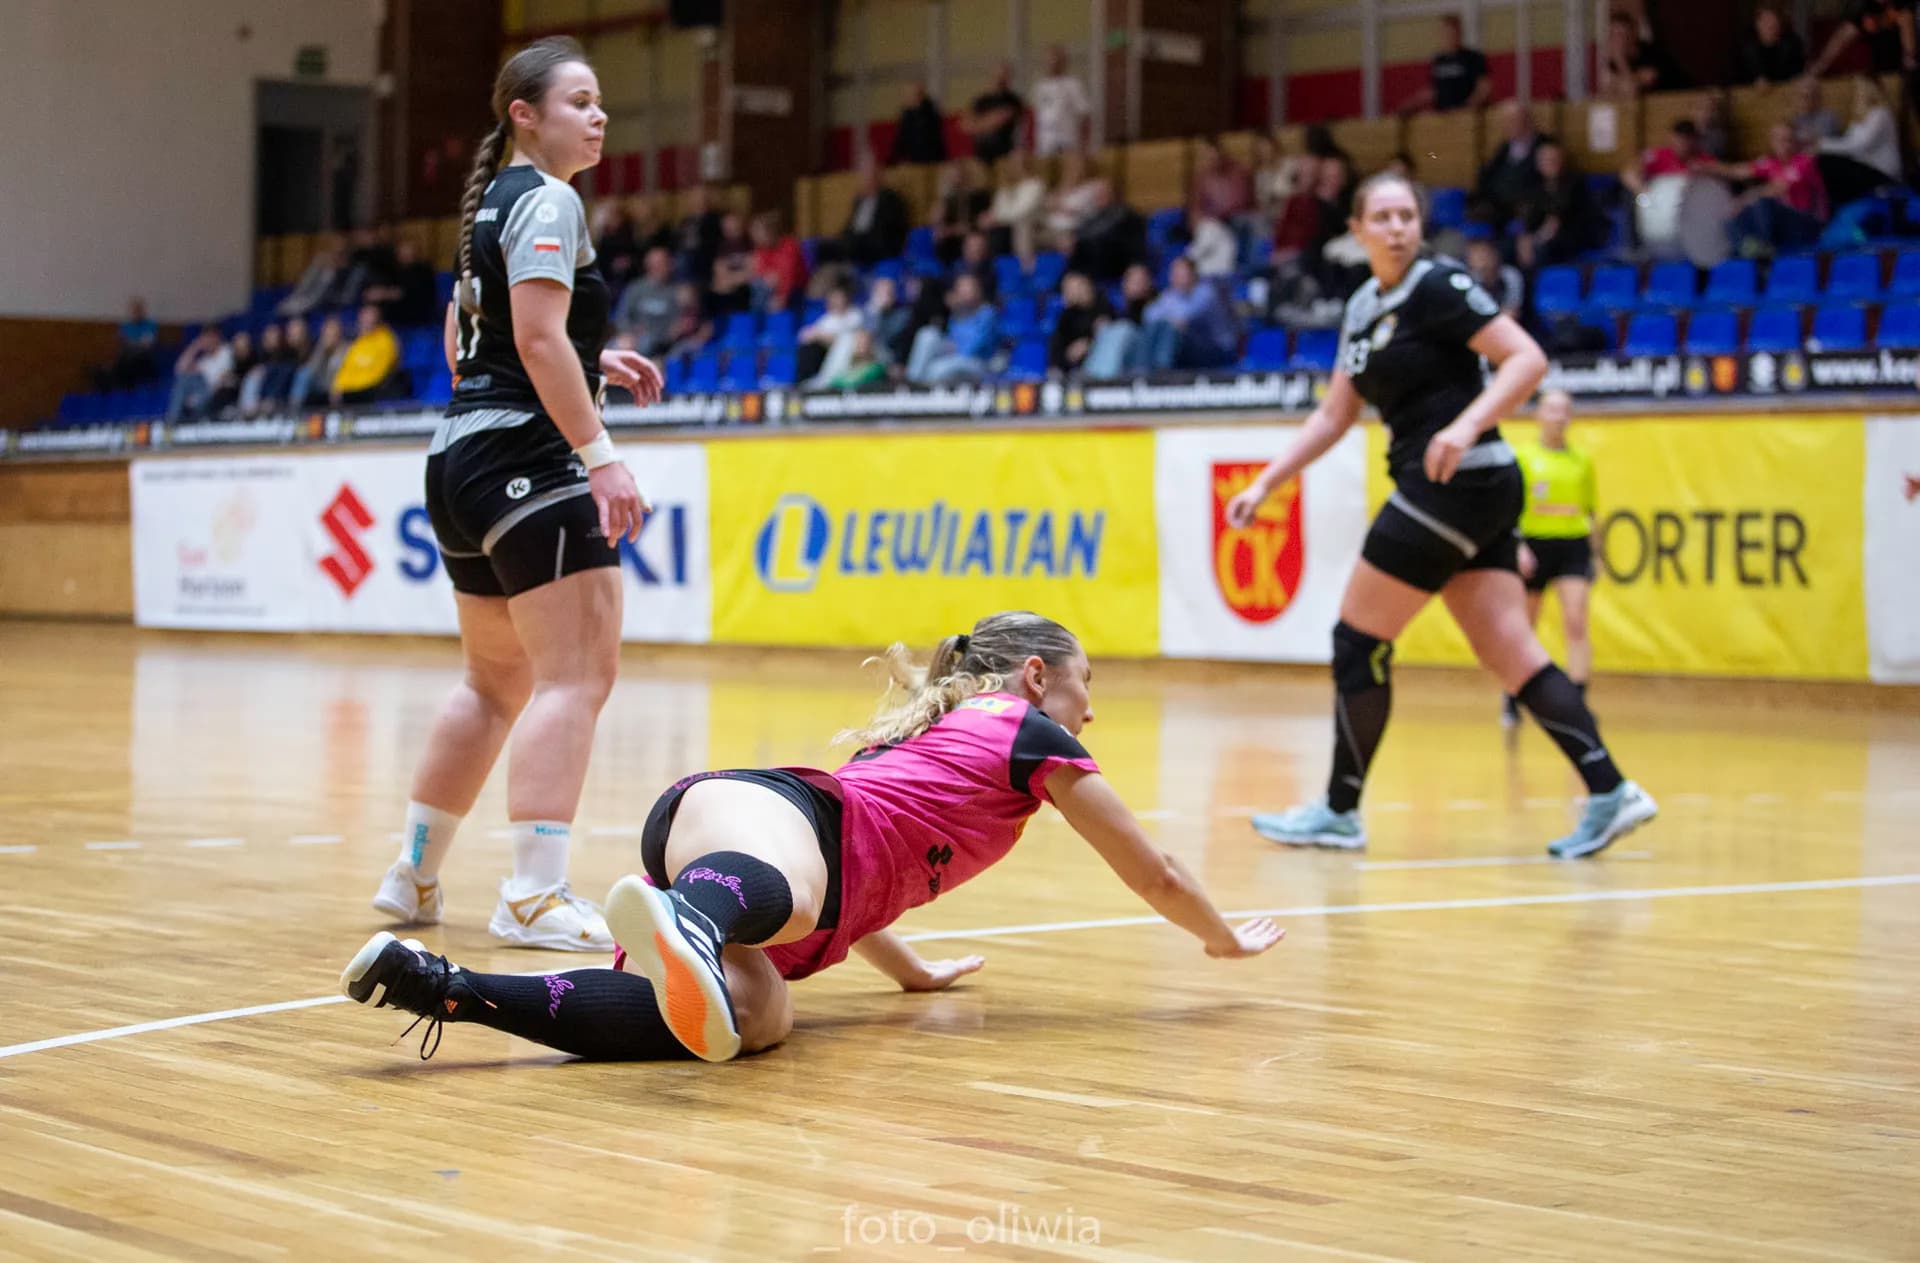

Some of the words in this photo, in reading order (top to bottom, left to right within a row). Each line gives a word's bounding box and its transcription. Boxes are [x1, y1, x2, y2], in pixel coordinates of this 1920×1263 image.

[397, 505, 688, 586] SKI
[837, 501, 1105, 578] LEWIATAN
[1602, 509, 1811, 588] ORTER
